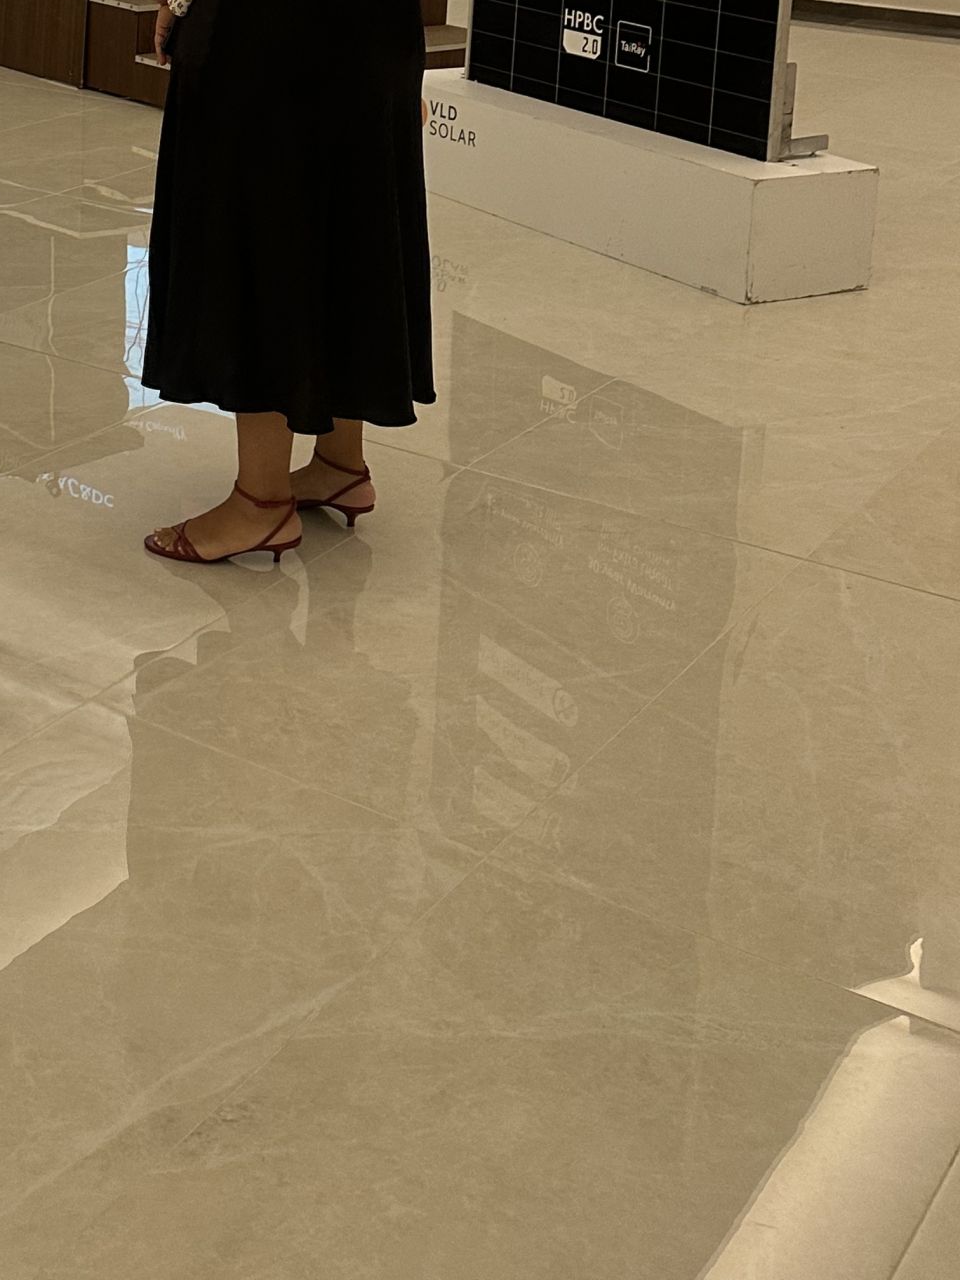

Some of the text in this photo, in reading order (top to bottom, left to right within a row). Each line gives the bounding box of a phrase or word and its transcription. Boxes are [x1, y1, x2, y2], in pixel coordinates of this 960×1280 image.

[564, 8, 605, 34] HPBC
[581, 36, 599, 56] 2.0
[429, 100, 458, 121] VLD
[429, 120, 477, 148] SOLAR
